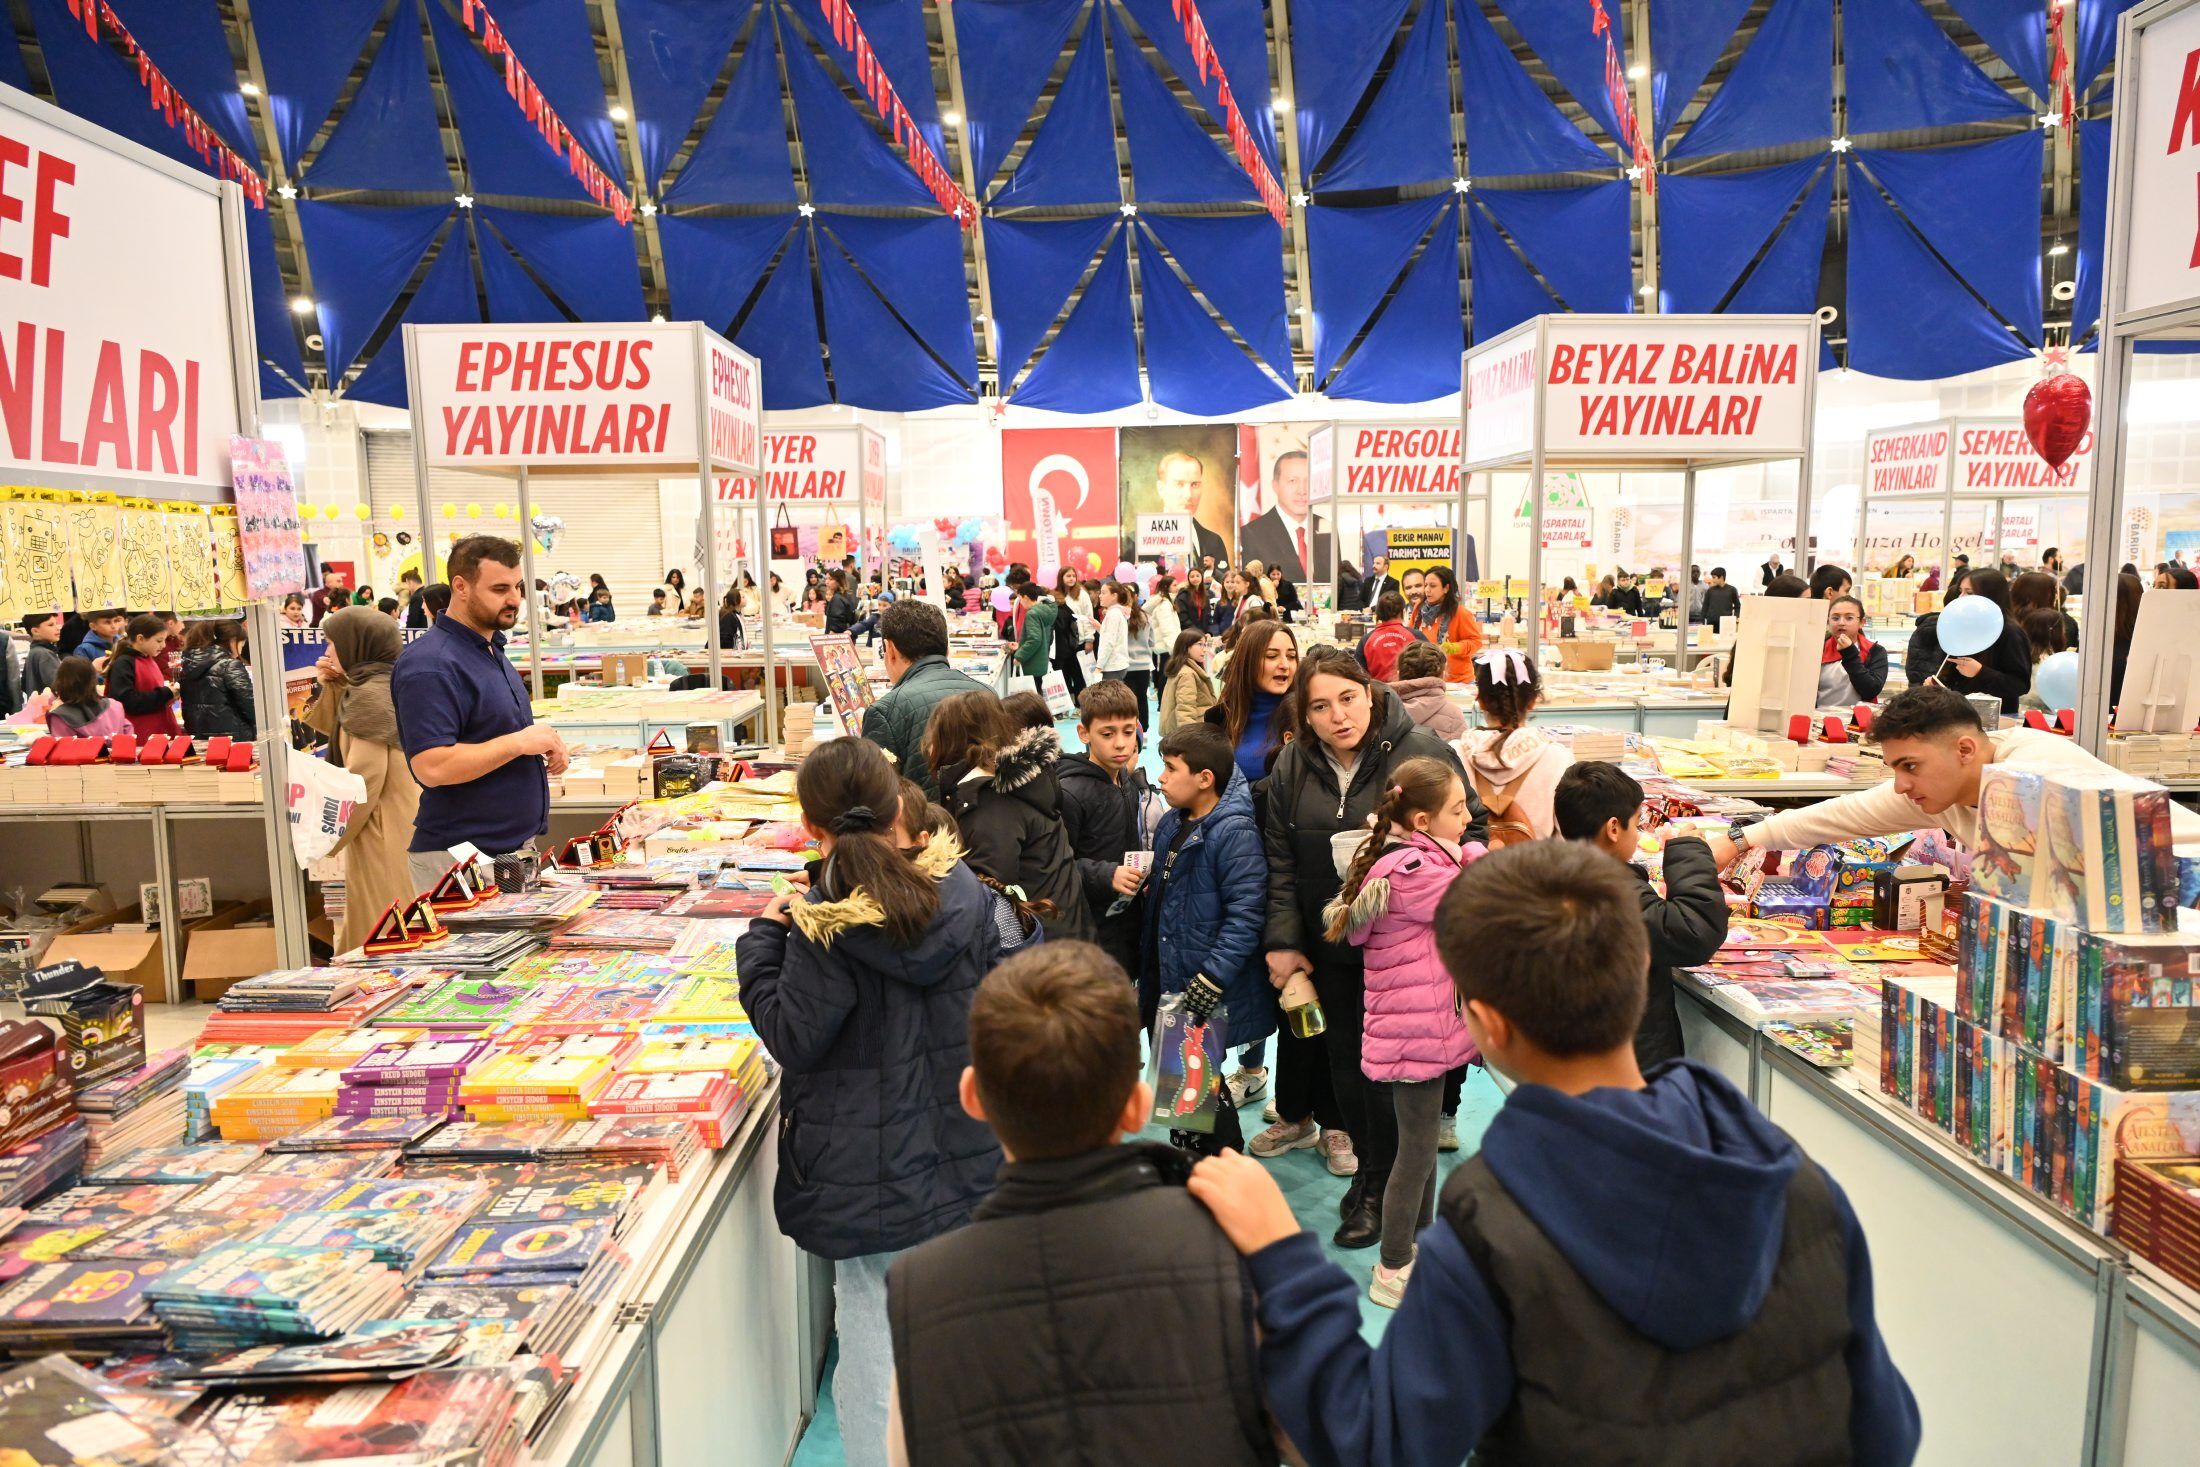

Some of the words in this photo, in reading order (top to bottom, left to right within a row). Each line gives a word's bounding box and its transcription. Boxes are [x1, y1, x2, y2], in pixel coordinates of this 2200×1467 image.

[456, 340, 652, 391] EPHESUS
[1548, 344, 1664, 384] BEYAZ
[712, 347, 751, 408] EPHESUS
[1577, 395, 1764, 436] YAYINLARI
[442, 403, 671, 455] YAYINLARI
[711, 405, 755, 466] YAYINLARI
[1870, 431, 1948, 463] SEMERKAND
[1959, 429, 2094, 455] SEMERD
[1873, 464, 1938, 492] YAYINLARI
[1966, 462, 2080, 488] YAYINLARI
[718, 470, 846, 500] YAYINLARI
[1151, 519, 1178, 532] AKAN
[1543, 519, 1586, 528] ISPARTALI
[1991, 516, 2034, 526] IPARTALI
[1417, 533, 1444, 542] MANAV
[1541, 531, 1586, 541] YAZARLAR
[1990, 528, 2034, 538] YZARLAR
[1142, 536, 1185, 546] YAYINLARI
[1422, 547, 1450, 558] YAZAR
[32, 963, 76, 983] Thunder
[401, 1069, 426, 1078] SUDOKU
[374, 1088, 402, 1096] EINSTEIN
[403, 1088, 427, 1096] SUDOKU
[374, 1098, 402, 1106] EINSTEIN
[402, 1097, 427, 1105] SUDOKU
[496, 1096, 524, 1104] EINSTEIN
[525, 1095, 549, 1103] SUDOKU
[398, 1106, 422, 1114] SUDOKU
[625, 1104, 654, 1113] EINSTEIN
[654, 1103, 678, 1112] SUDOKU
